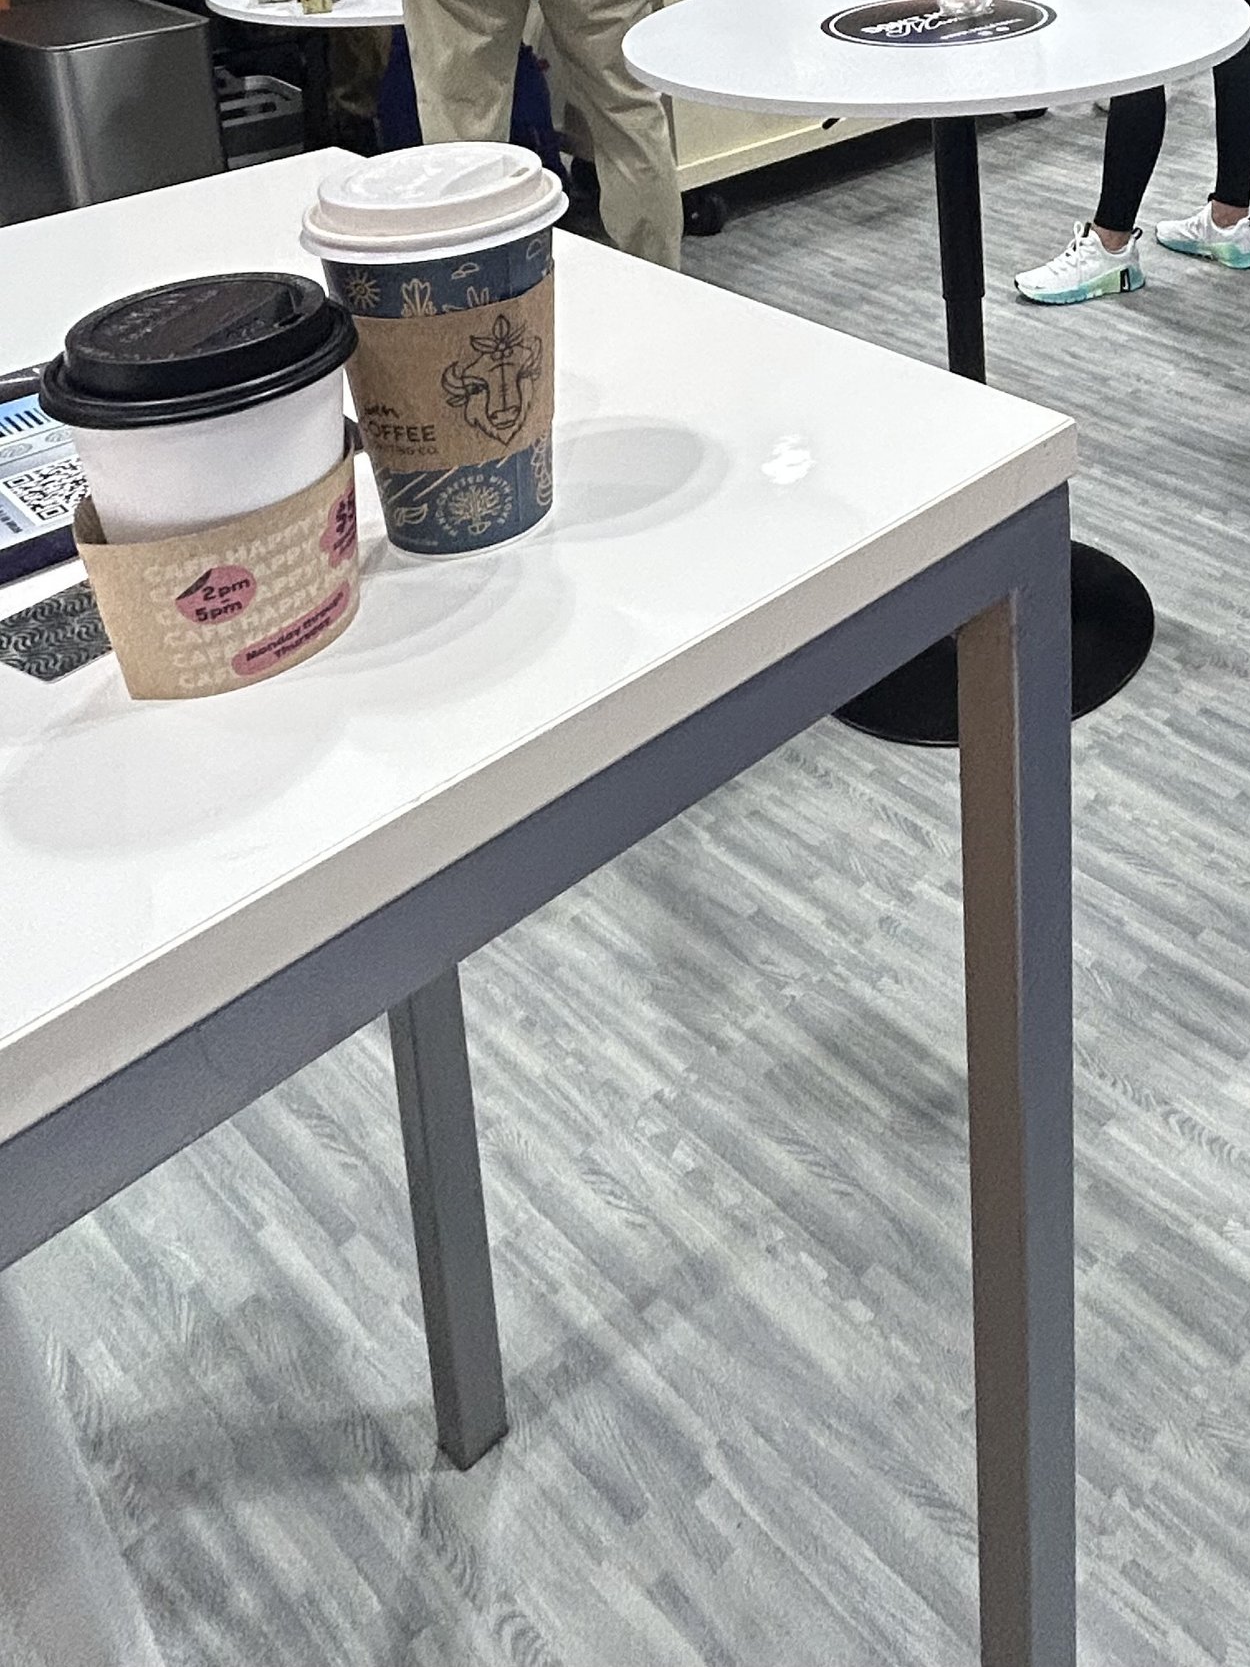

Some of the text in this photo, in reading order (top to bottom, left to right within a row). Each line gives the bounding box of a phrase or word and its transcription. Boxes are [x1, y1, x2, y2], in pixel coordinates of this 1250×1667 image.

[366, 420, 437, 442] OFFEE
[202, 577, 251, 603] 2pm
[195, 600, 243, 623] 5pm
[246, 626, 301, 662] Monday
